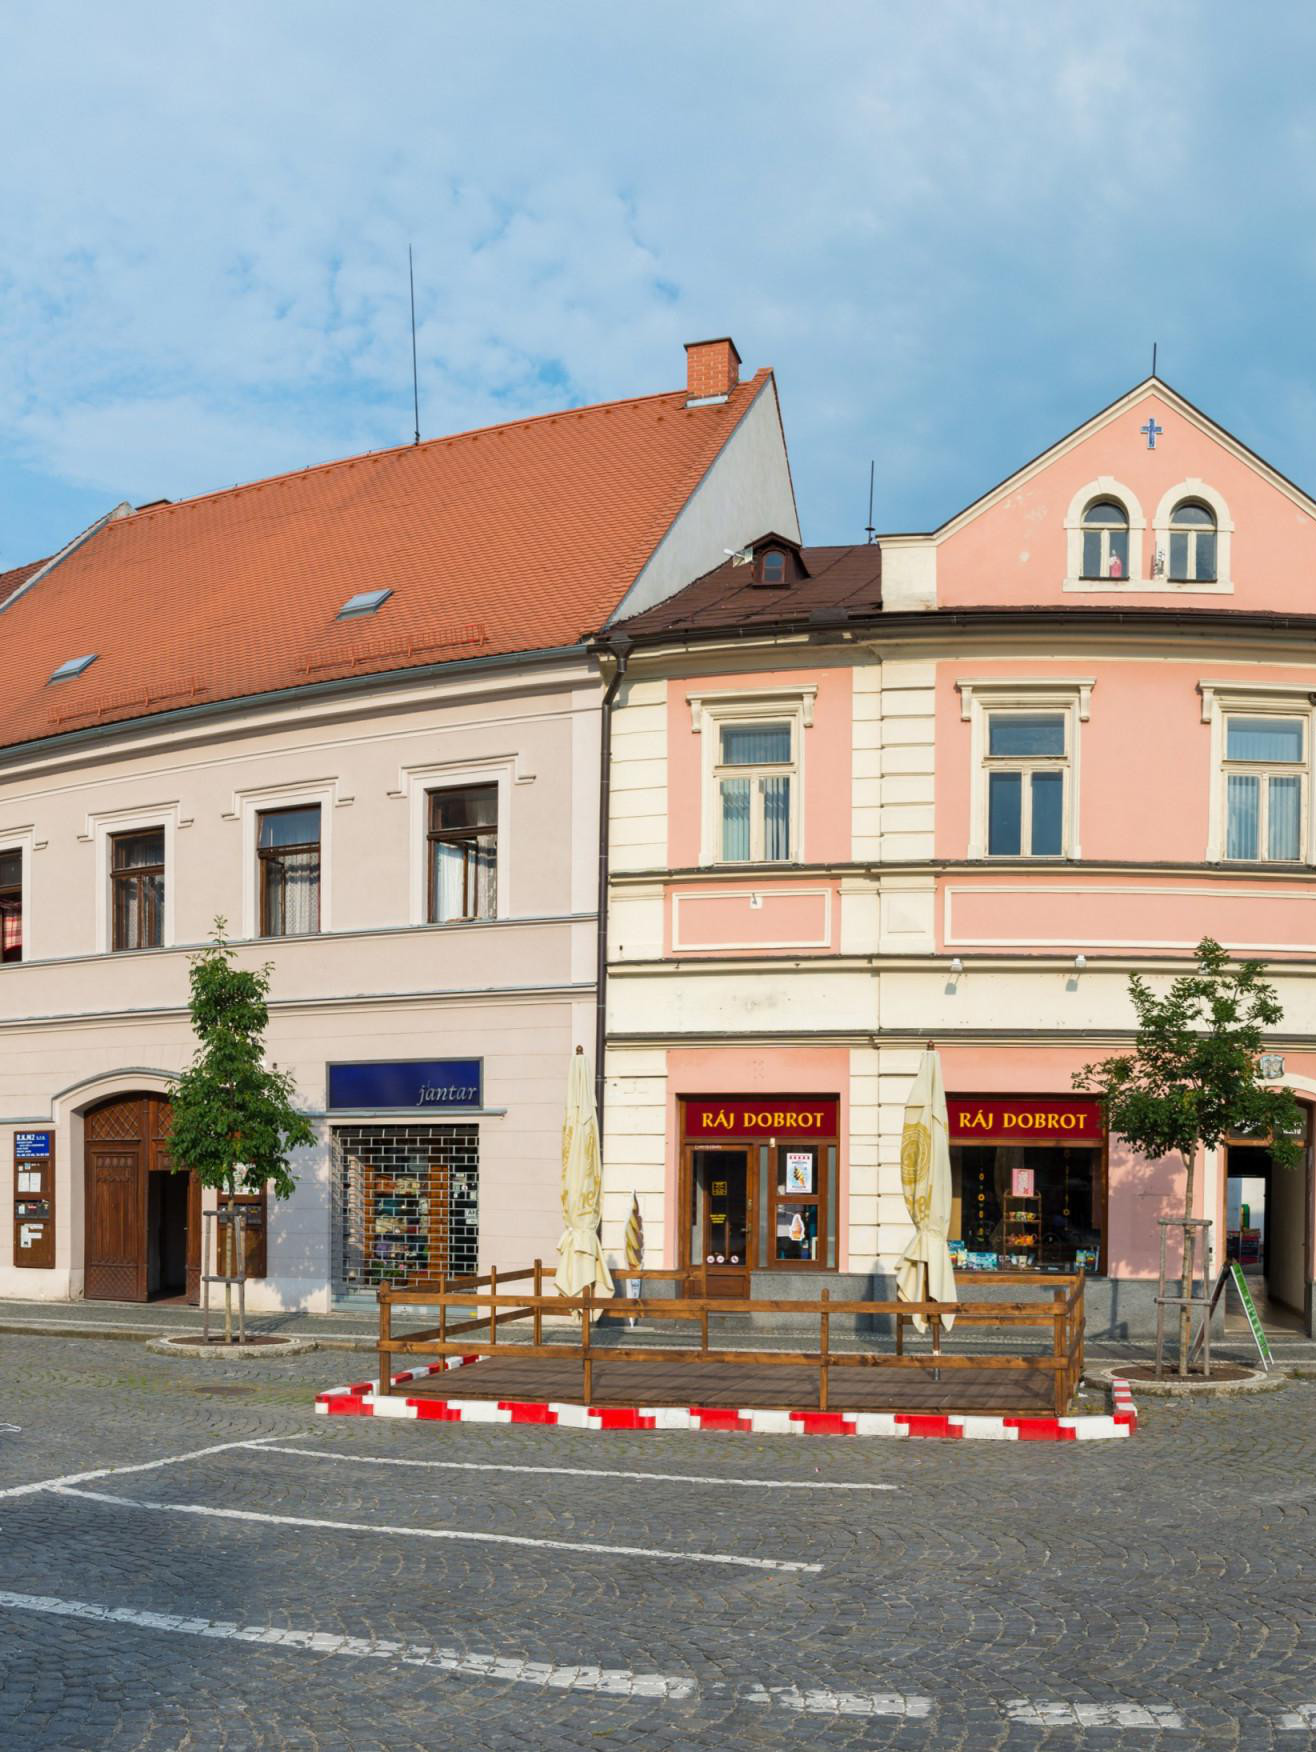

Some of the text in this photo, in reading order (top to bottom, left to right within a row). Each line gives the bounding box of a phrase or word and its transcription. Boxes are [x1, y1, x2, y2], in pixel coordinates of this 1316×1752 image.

[416, 1084, 477, 1106] jantar
[702, 1109, 824, 1130] RÁJ DOBROT
[959, 1109, 1088, 1130] RÁJ DOBROT
